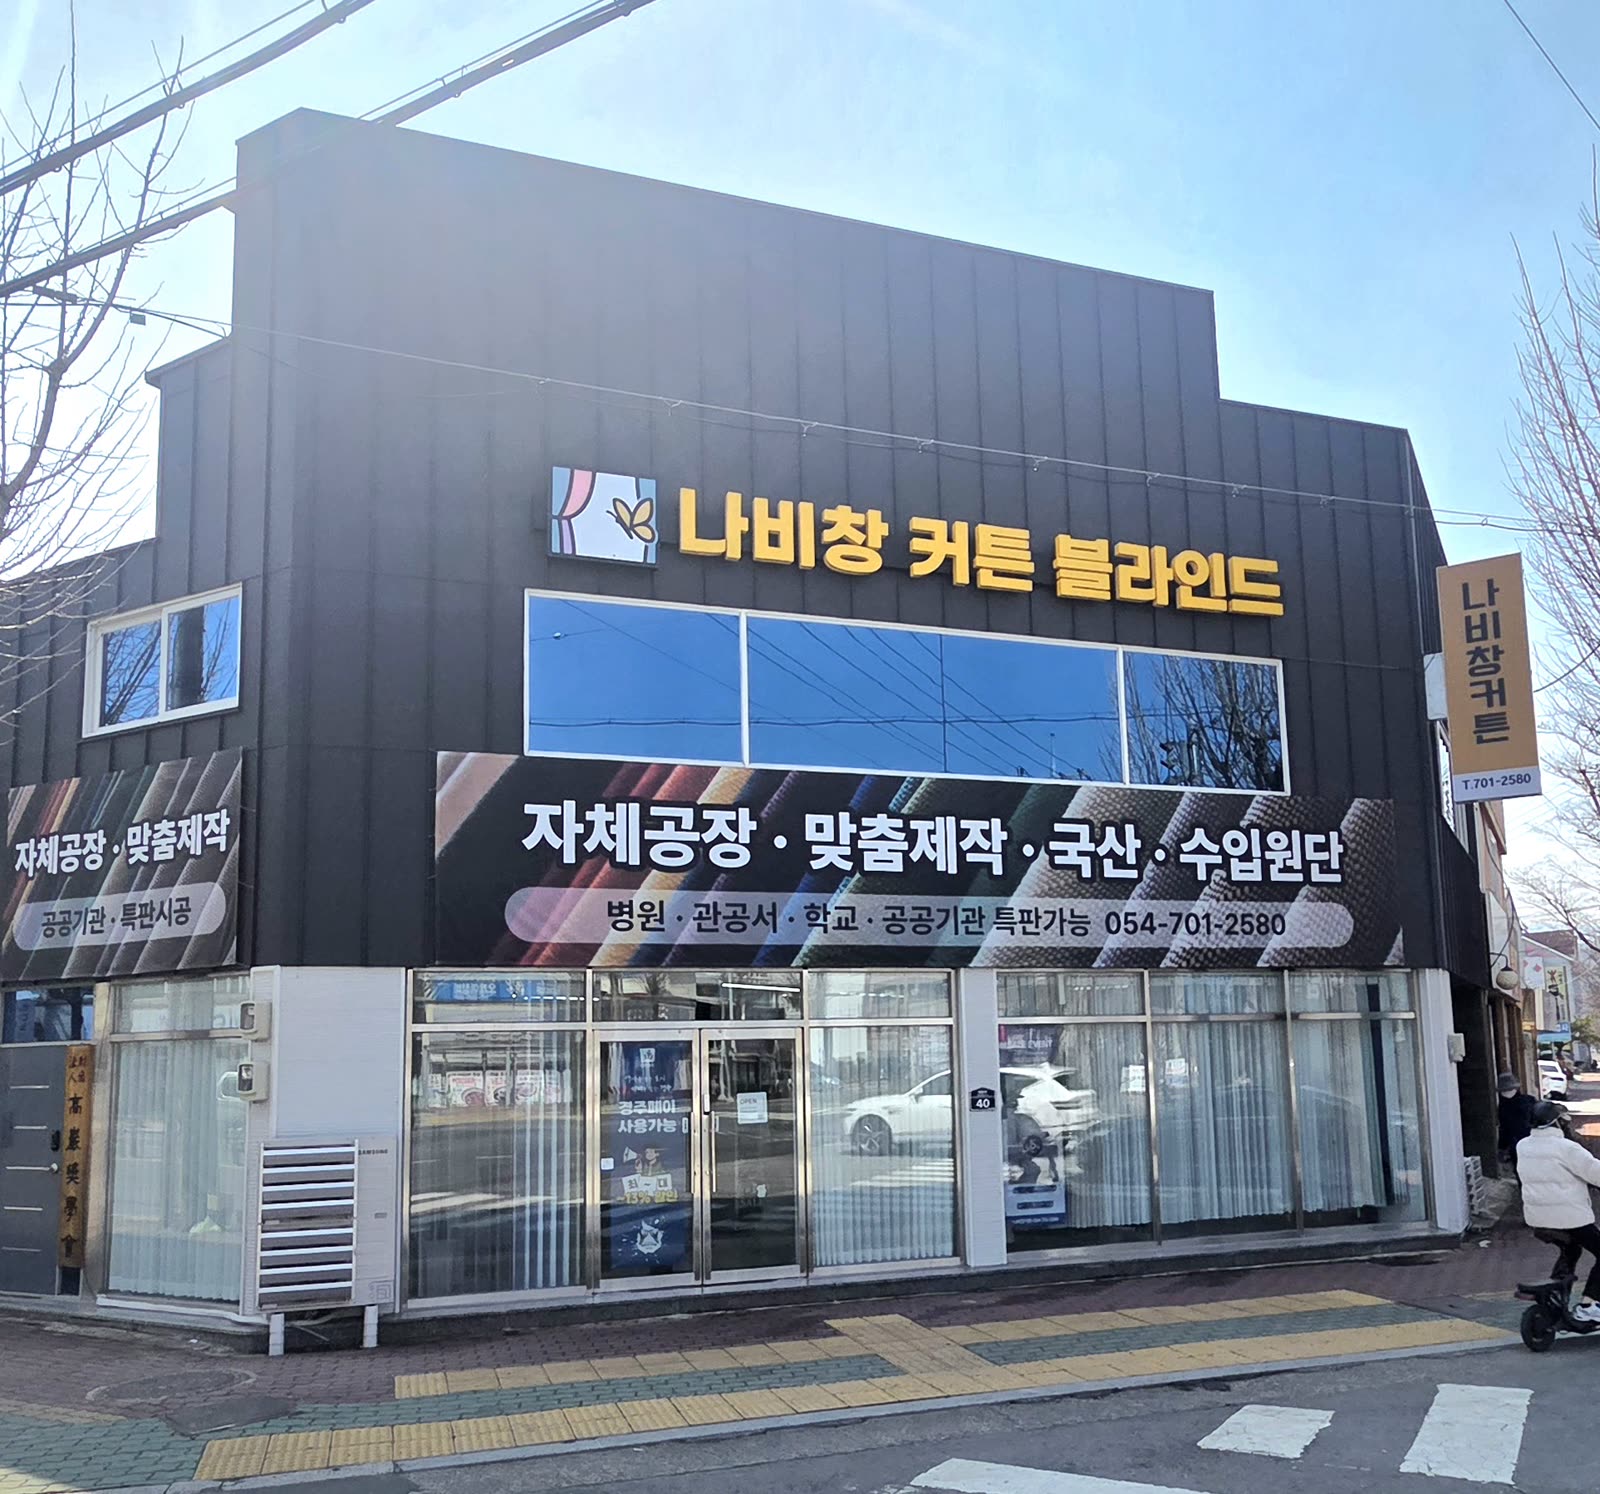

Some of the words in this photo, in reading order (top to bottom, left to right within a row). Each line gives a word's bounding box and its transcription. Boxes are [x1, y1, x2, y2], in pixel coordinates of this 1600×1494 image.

[678, 487, 889, 576] 나비창
[908, 516, 1036, 592] 커튼
[1054, 533, 1284, 616] 블라인드
[1462, 578, 1510, 745] 나비창커튼
[1462, 772, 1532, 791] T.701-2580
[15, 829, 107, 878] 자체공장
[127, 808, 231, 866] 맞춤제작
[521, 800, 758, 869] 자체공장
[804, 811, 1008, 877] 맞춤제작
[1048, 821, 1141, 879] 국산
[1178, 827, 1344, 884] 수입원단
[41, 904, 106, 939] 공공기관
[120, 896, 192, 932] 특판시공
[607, 899, 666, 933] 병원
[692, 901, 778, 935] 관공서
[803, 903, 860, 934] 학교
[882, 904, 986, 937] 공공기관
[995, 906, 1092, 938] 특판가능
[1104, 911, 1287, 937] 054-701-2580
[976, 1098, 990, 1108] 40
[618, 1118, 677, 1134] 사용가능
